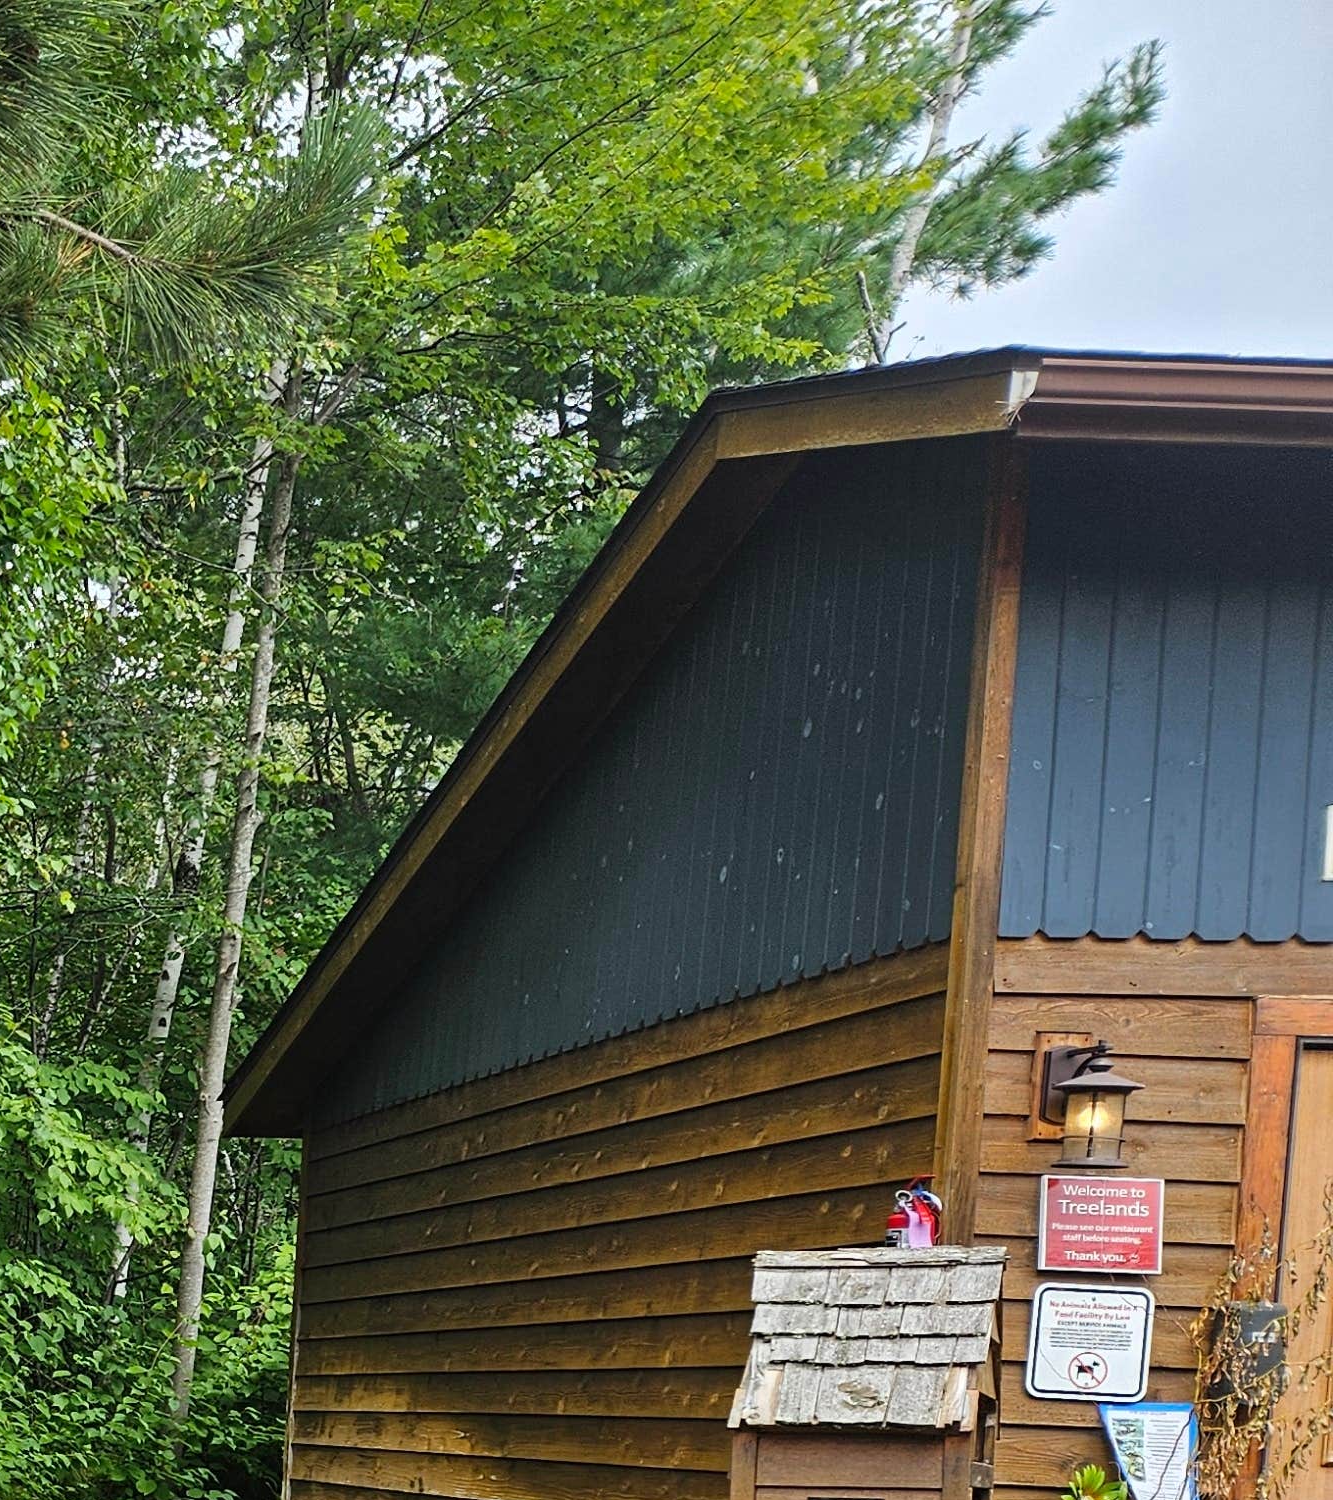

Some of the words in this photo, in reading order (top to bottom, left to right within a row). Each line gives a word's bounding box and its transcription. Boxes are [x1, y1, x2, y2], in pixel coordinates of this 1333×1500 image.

[1063, 1184, 1127, 1198] Welcome
[1130, 1187, 1145, 1198] to
[1058, 1200, 1149, 1216] Treelands
[1052, 1223, 1079, 1231] Please
[1111, 1225, 1153, 1233] restaurant
[1083, 1234, 1110, 1243] before
[1064, 1250, 1100, 1261] Thank
[1102, 1253, 1127, 1263] you.
